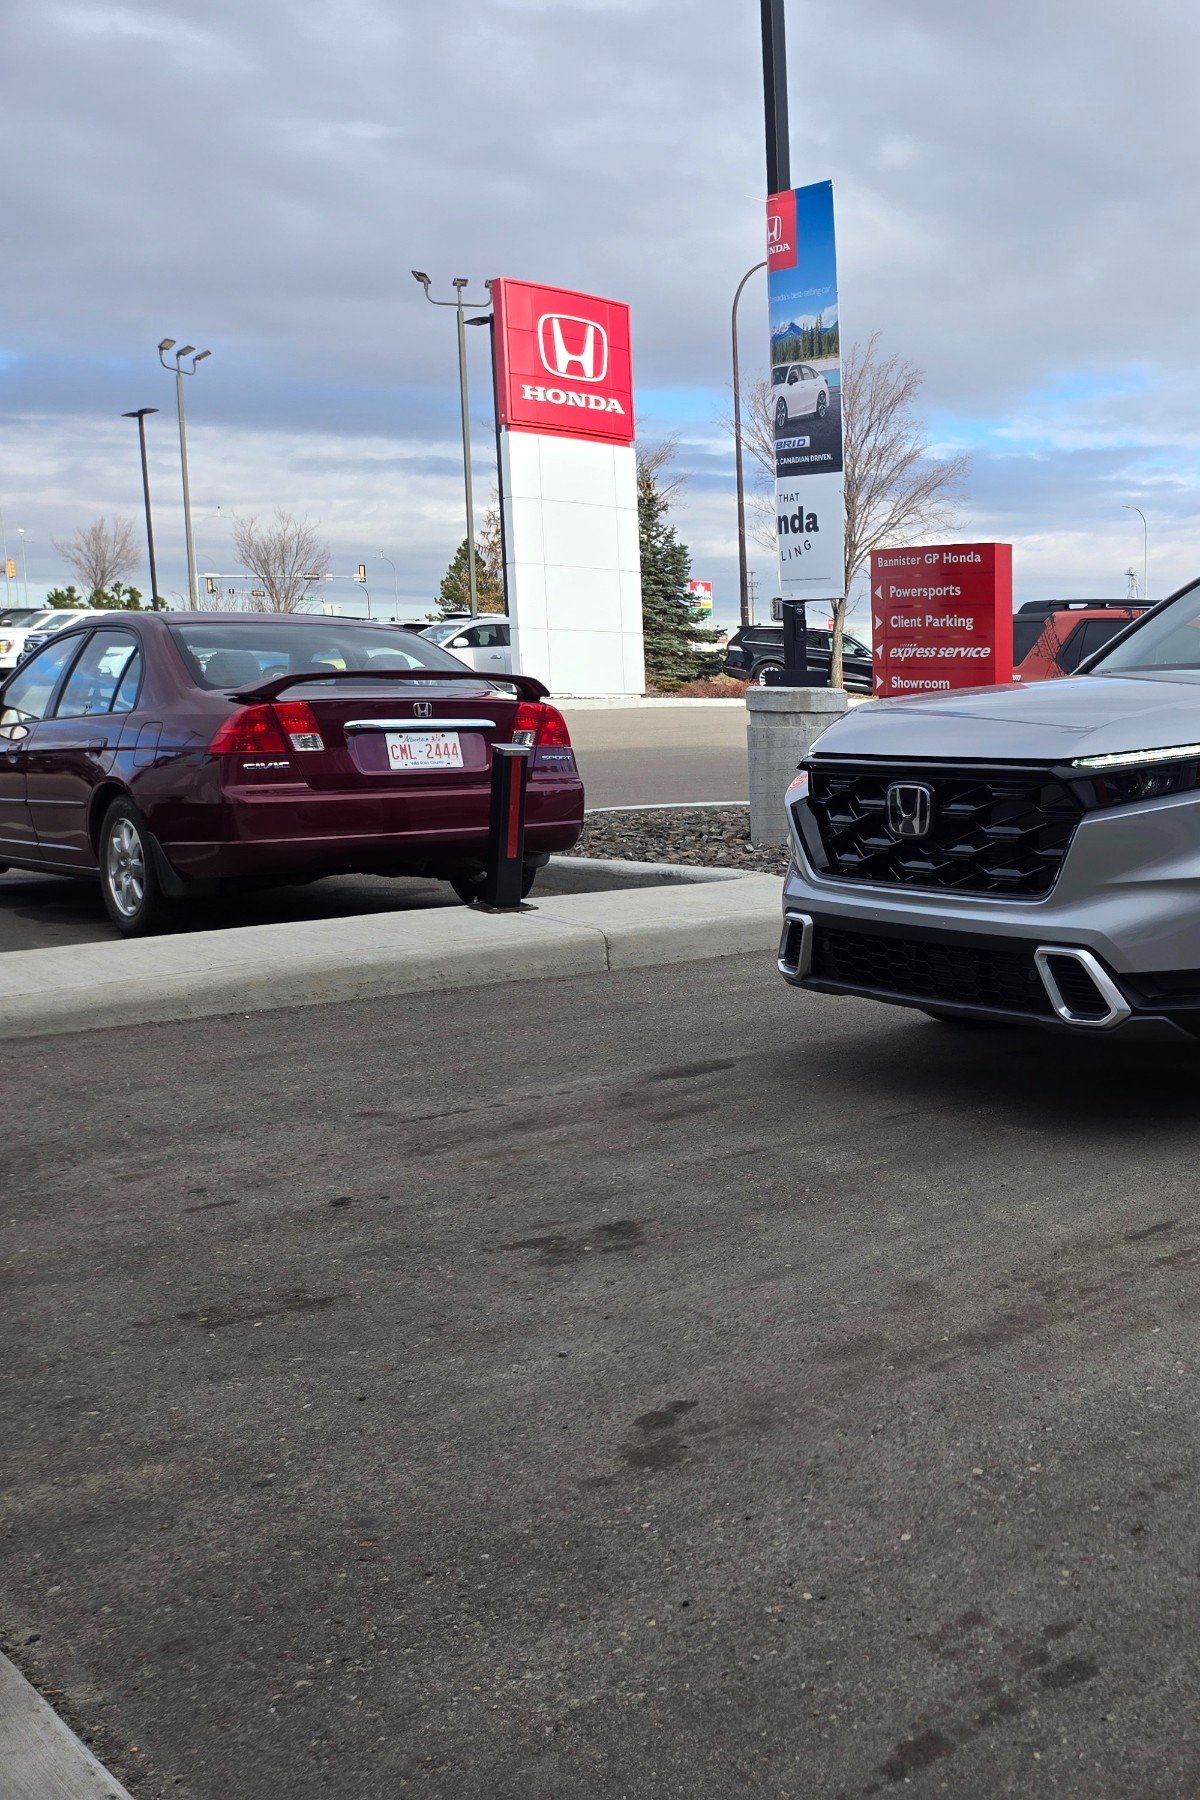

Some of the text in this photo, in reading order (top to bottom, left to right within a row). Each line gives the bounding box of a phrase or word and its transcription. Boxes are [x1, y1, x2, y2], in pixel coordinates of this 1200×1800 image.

[769, 243, 790, 254] NDA
[521, 384, 625, 415] HONDA
[775, 438, 806, 450] BRID
[780, 455, 810, 465] CANADIAN
[779, 493, 800, 503] THAT
[878, 552, 981, 568] Bannister GP Honda
[889, 585, 961, 600] Powersports
[890, 614, 974, 630] Client Parking
[889, 645, 991, 661] express service
[891, 676, 950, 690] Showroom
[402, 734, 427, 743] Alberta
[390, 742, 459, 760] CML-2444
[243, 761, 291, 770] CIVIC
